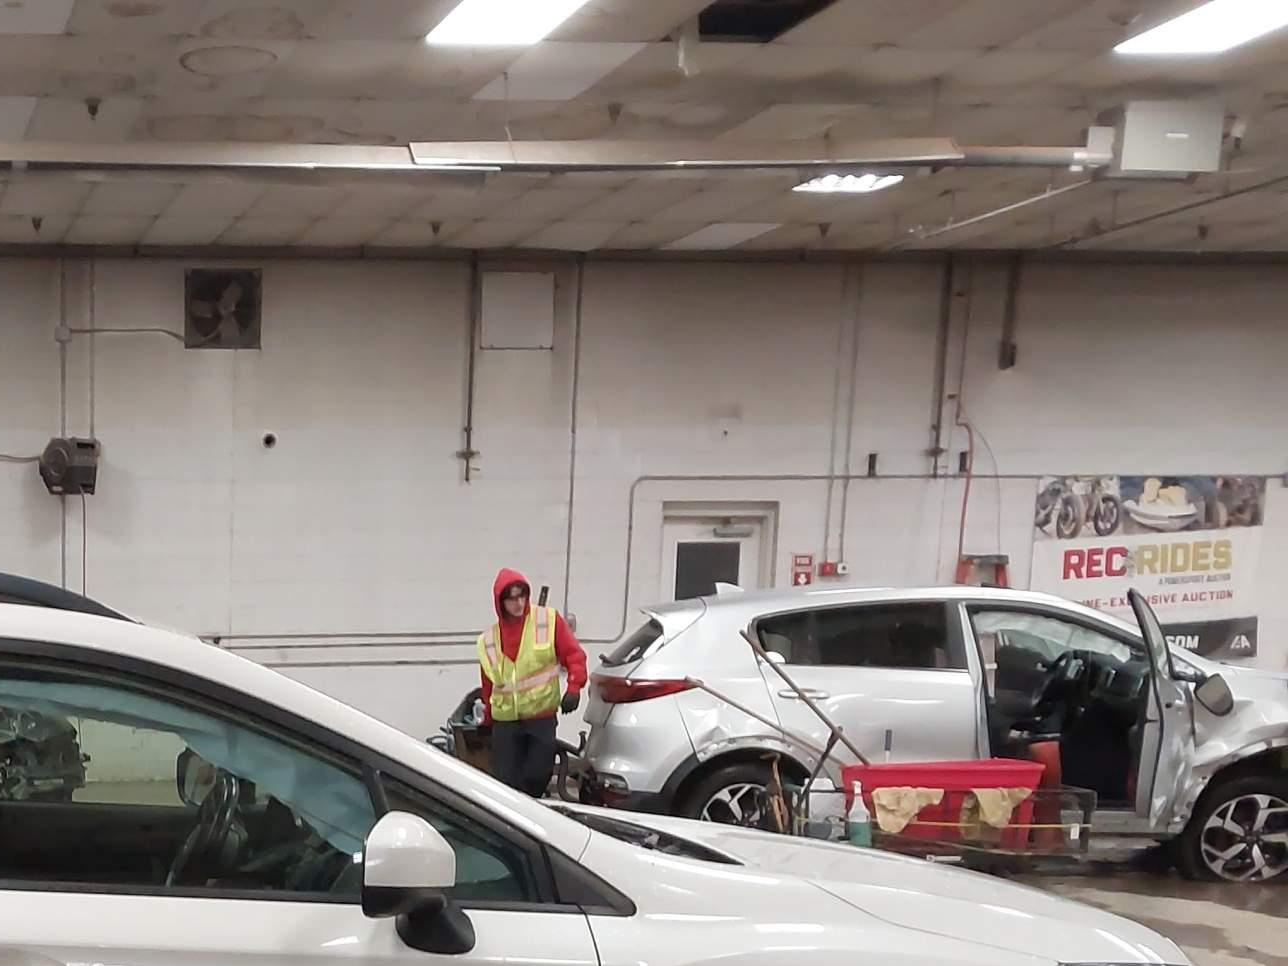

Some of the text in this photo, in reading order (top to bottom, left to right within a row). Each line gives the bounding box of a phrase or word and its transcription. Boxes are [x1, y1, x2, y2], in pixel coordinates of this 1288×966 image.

[1062, 539, 1233, 580] REC RIDES
[1182, 589, 1234, 603] AUCTION
